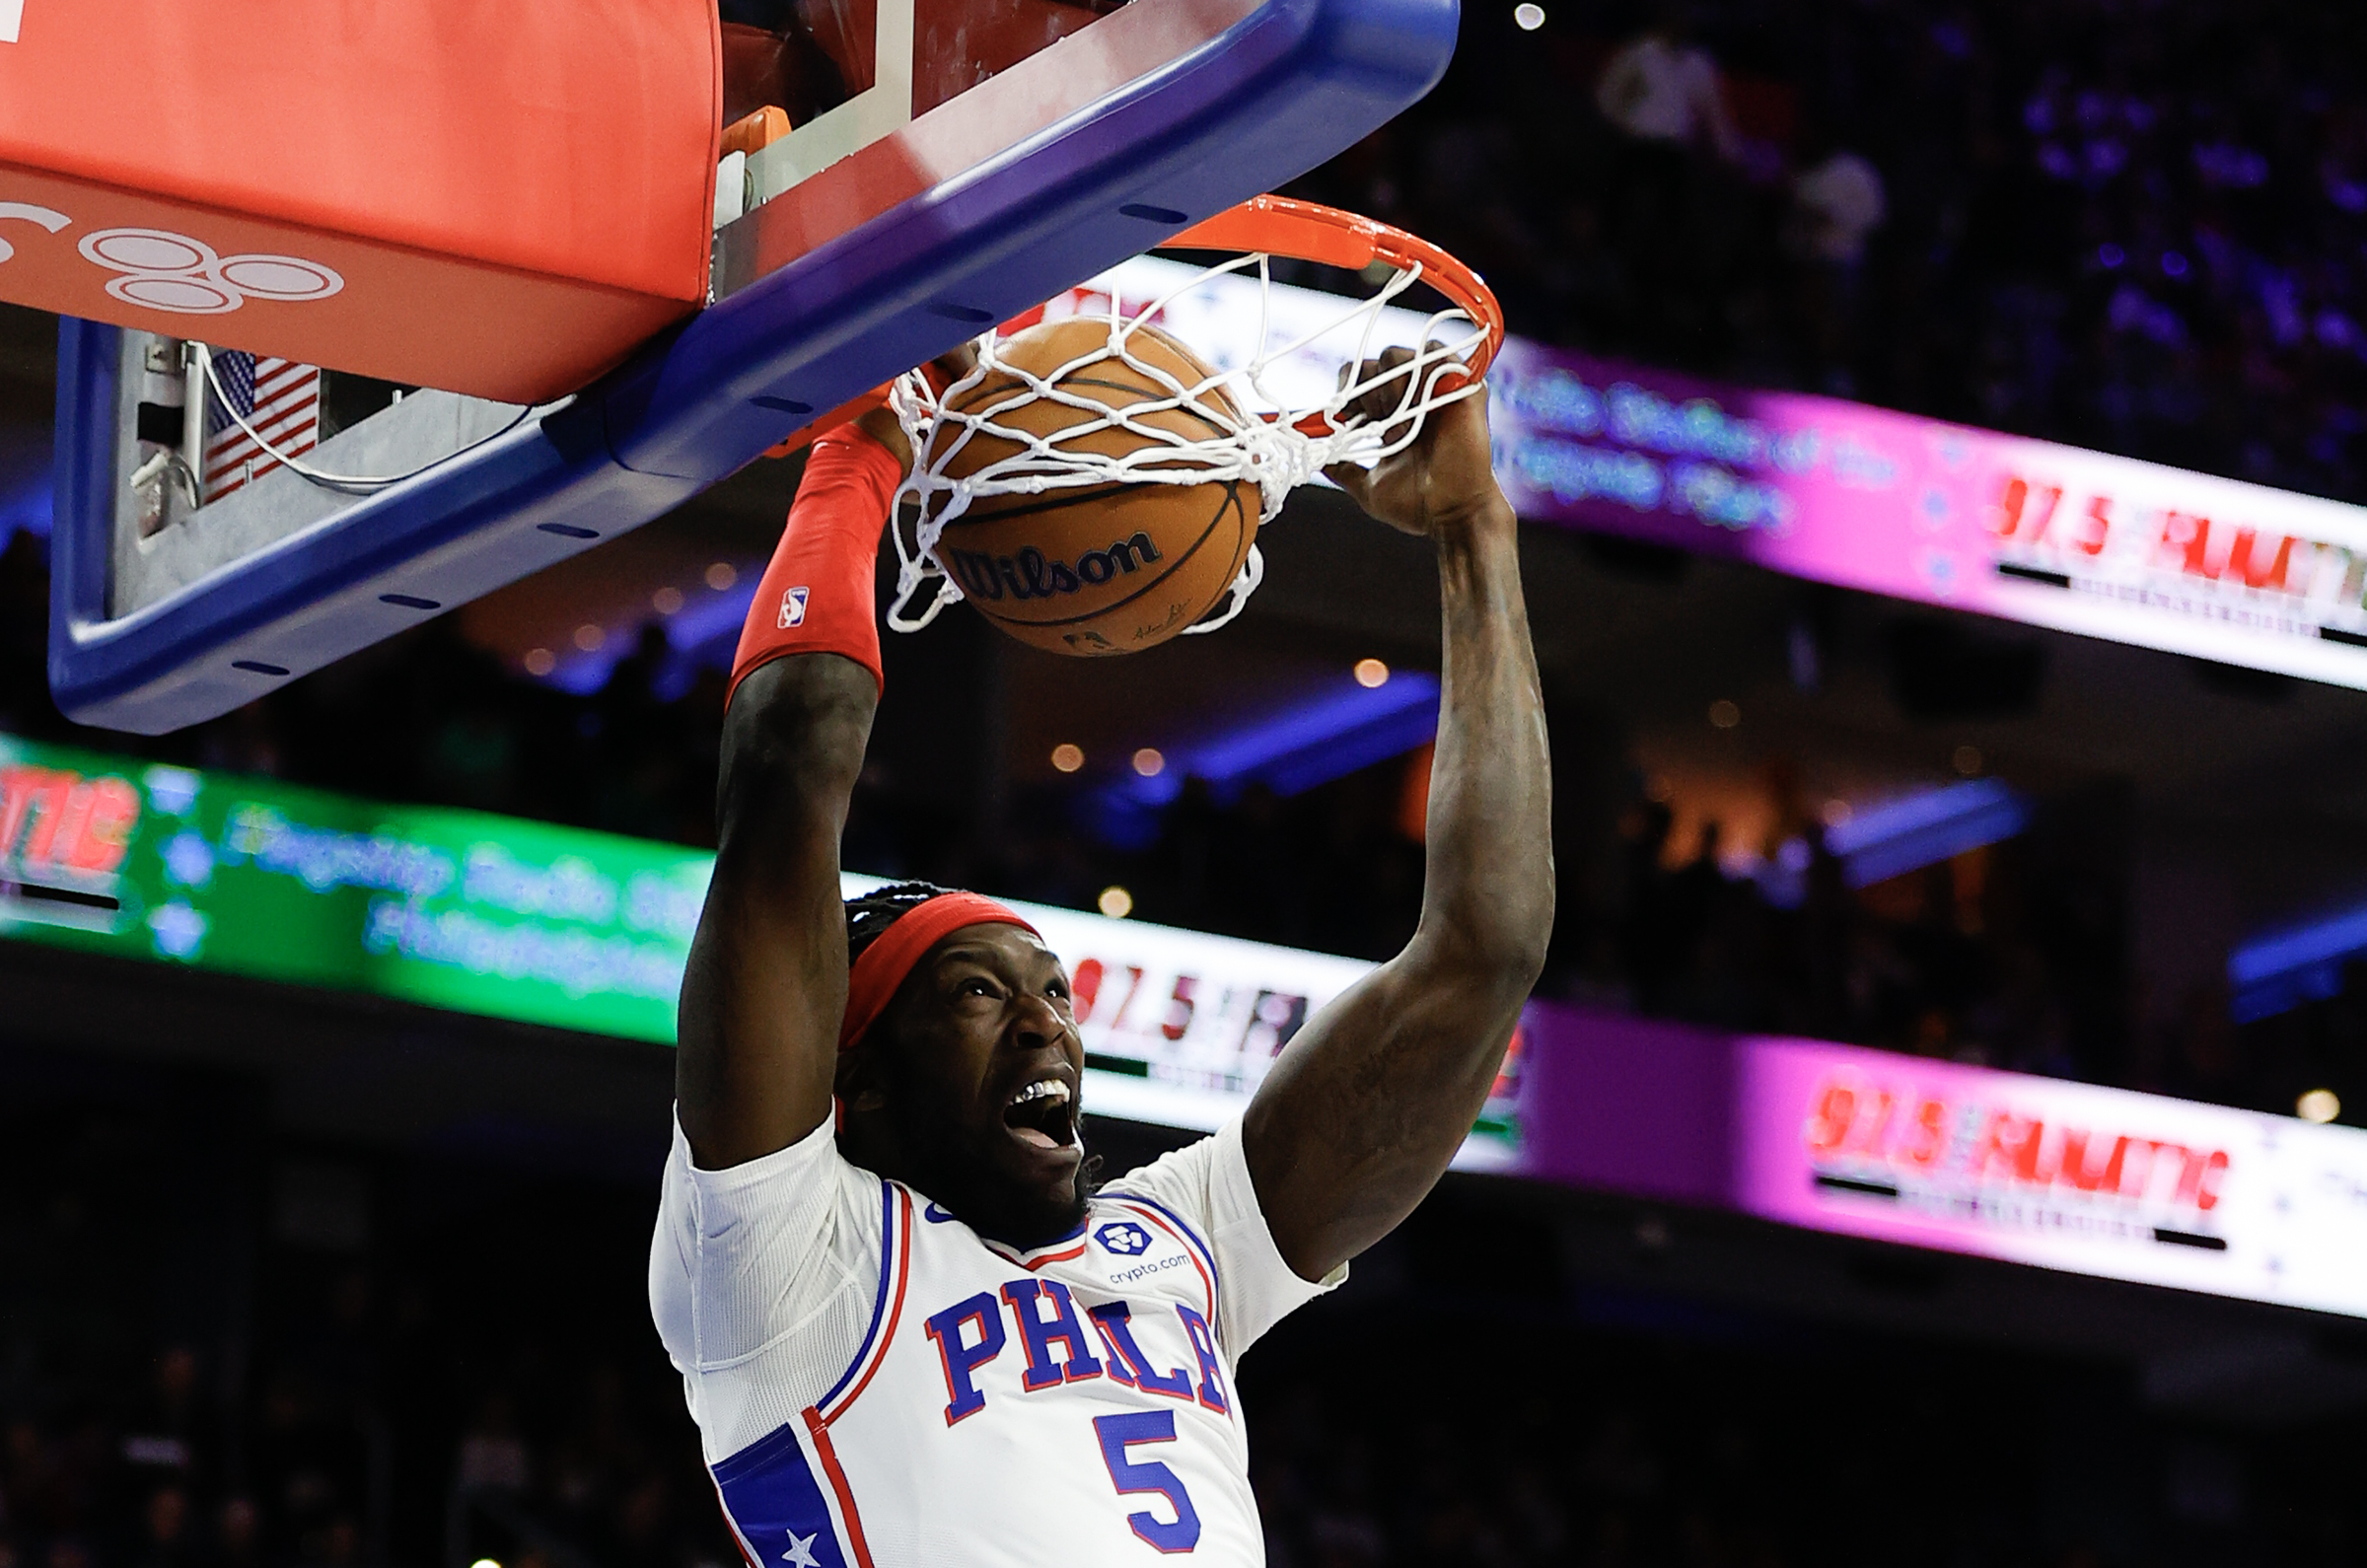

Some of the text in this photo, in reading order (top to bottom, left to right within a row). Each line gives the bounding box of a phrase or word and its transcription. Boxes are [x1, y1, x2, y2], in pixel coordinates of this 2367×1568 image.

[950, 531, 1162, 602] Wilson
[1110, 1253, 1190, 1284] crypto.com
[1093, 1409, 1201, 1554] 5
